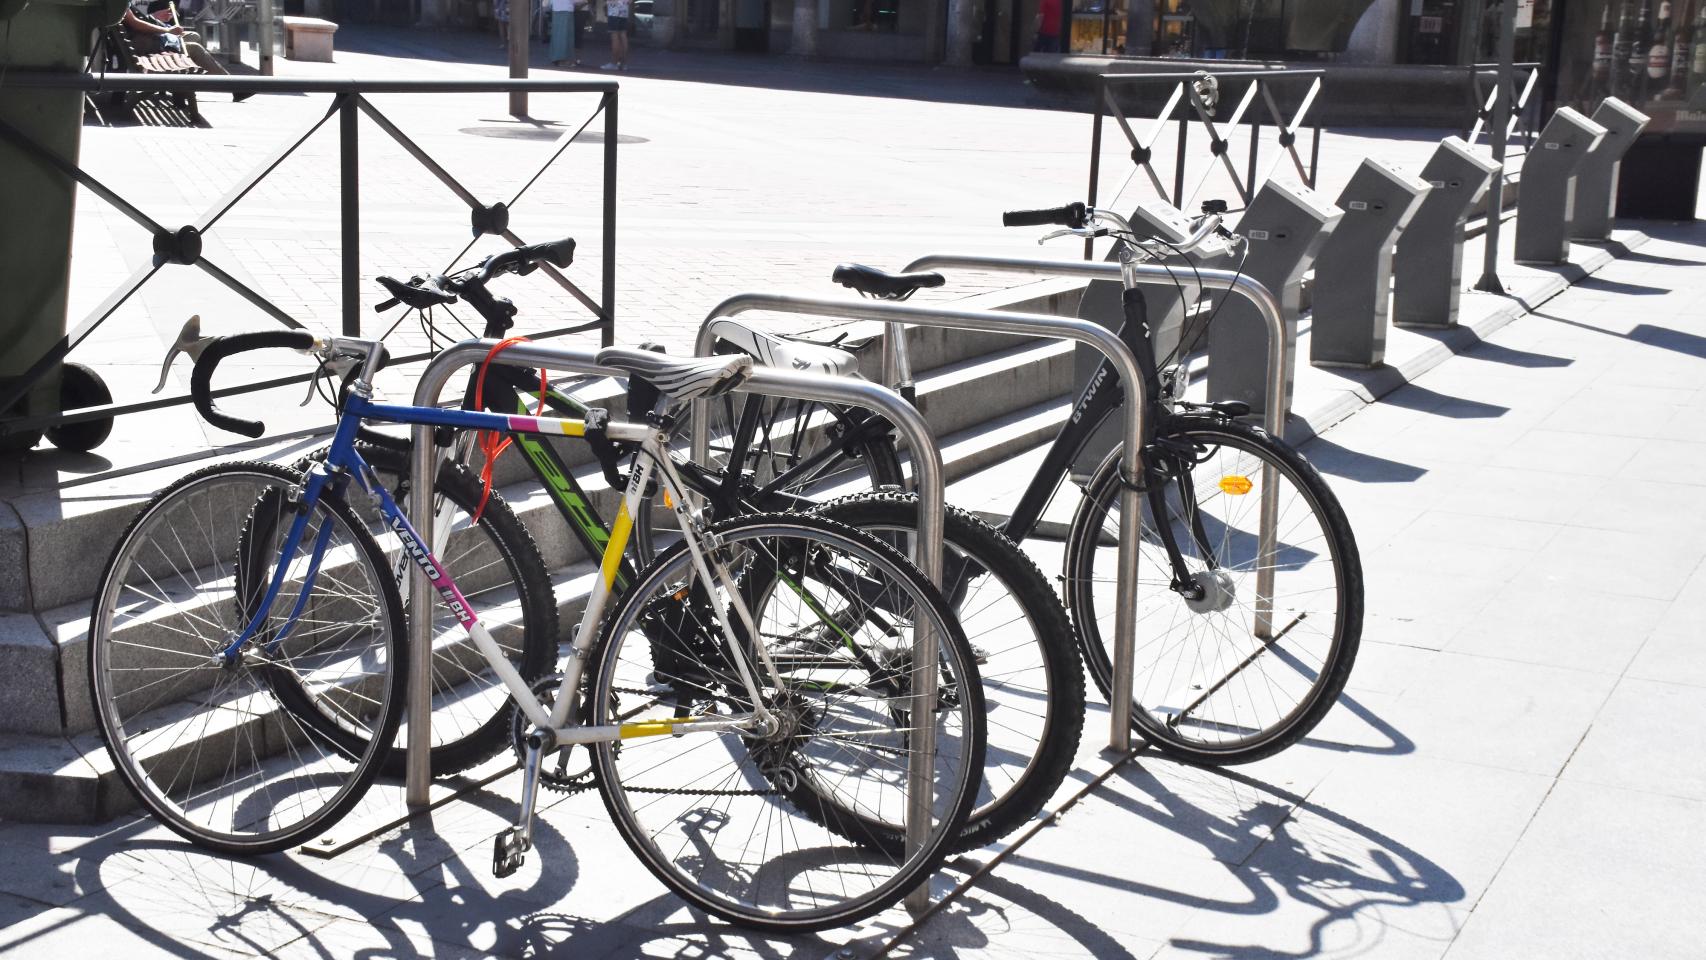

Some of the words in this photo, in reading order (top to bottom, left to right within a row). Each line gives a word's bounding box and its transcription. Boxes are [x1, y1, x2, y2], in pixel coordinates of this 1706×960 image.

[633, 464, 644, 485] BH
[391, 517, 441, 581] VENTO
[451, 601, 471, 622] BH
